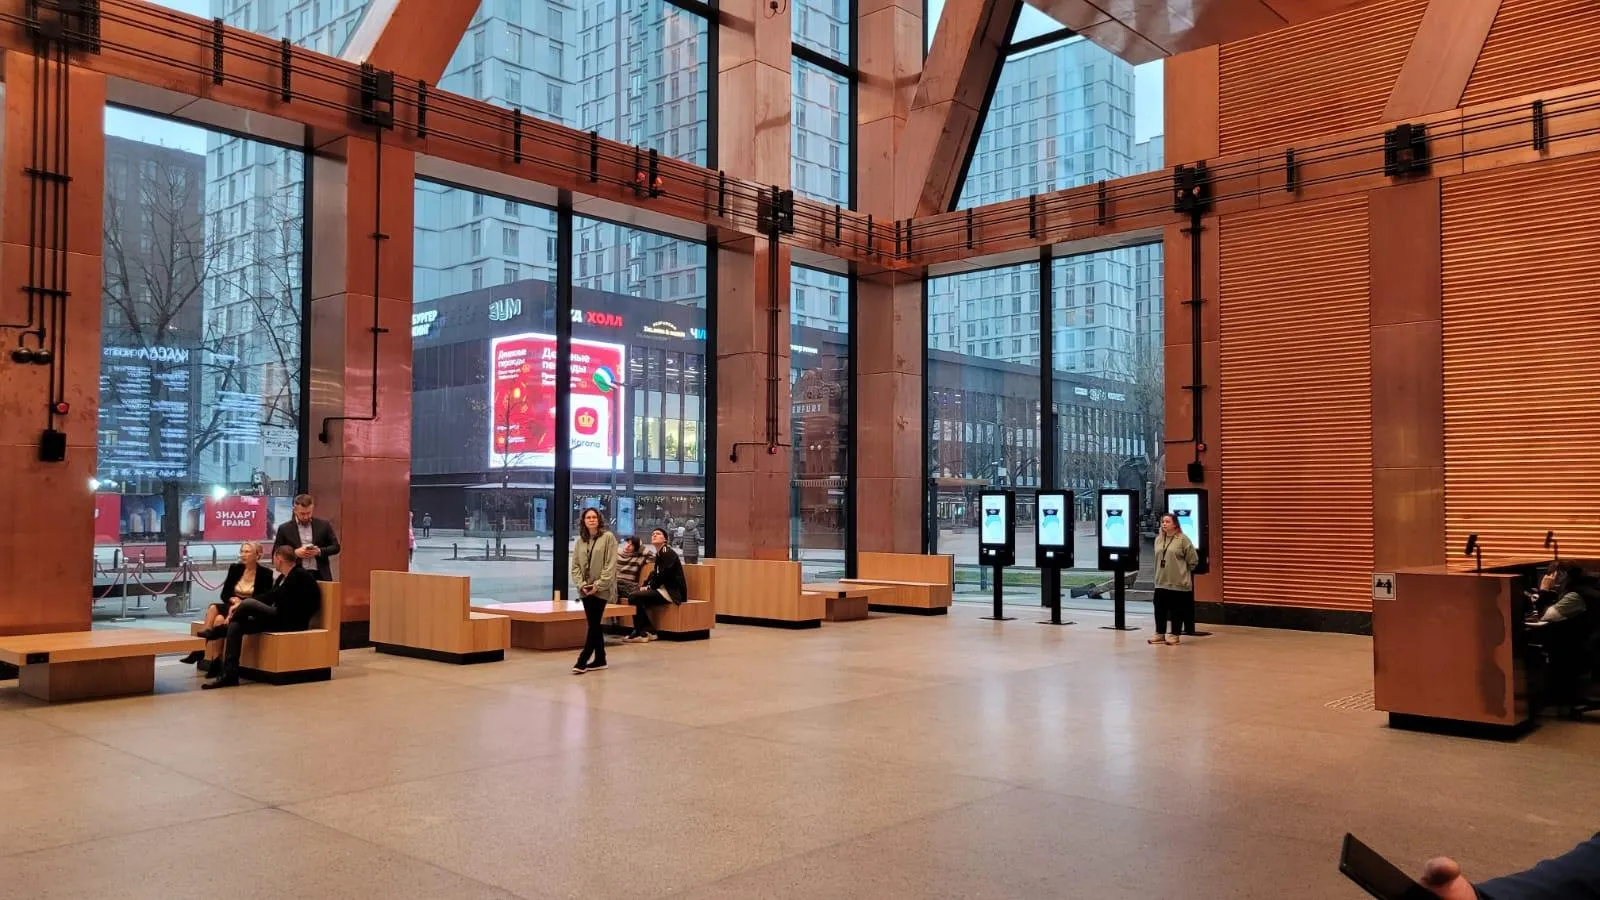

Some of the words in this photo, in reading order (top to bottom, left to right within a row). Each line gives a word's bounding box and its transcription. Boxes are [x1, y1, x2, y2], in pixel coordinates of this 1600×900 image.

[586, 311, 623, 327] ХОЛЛ
[215, 510, 257, 519] ЗИЛАРТ
[222, 519, 252, 527] ГРАНД
